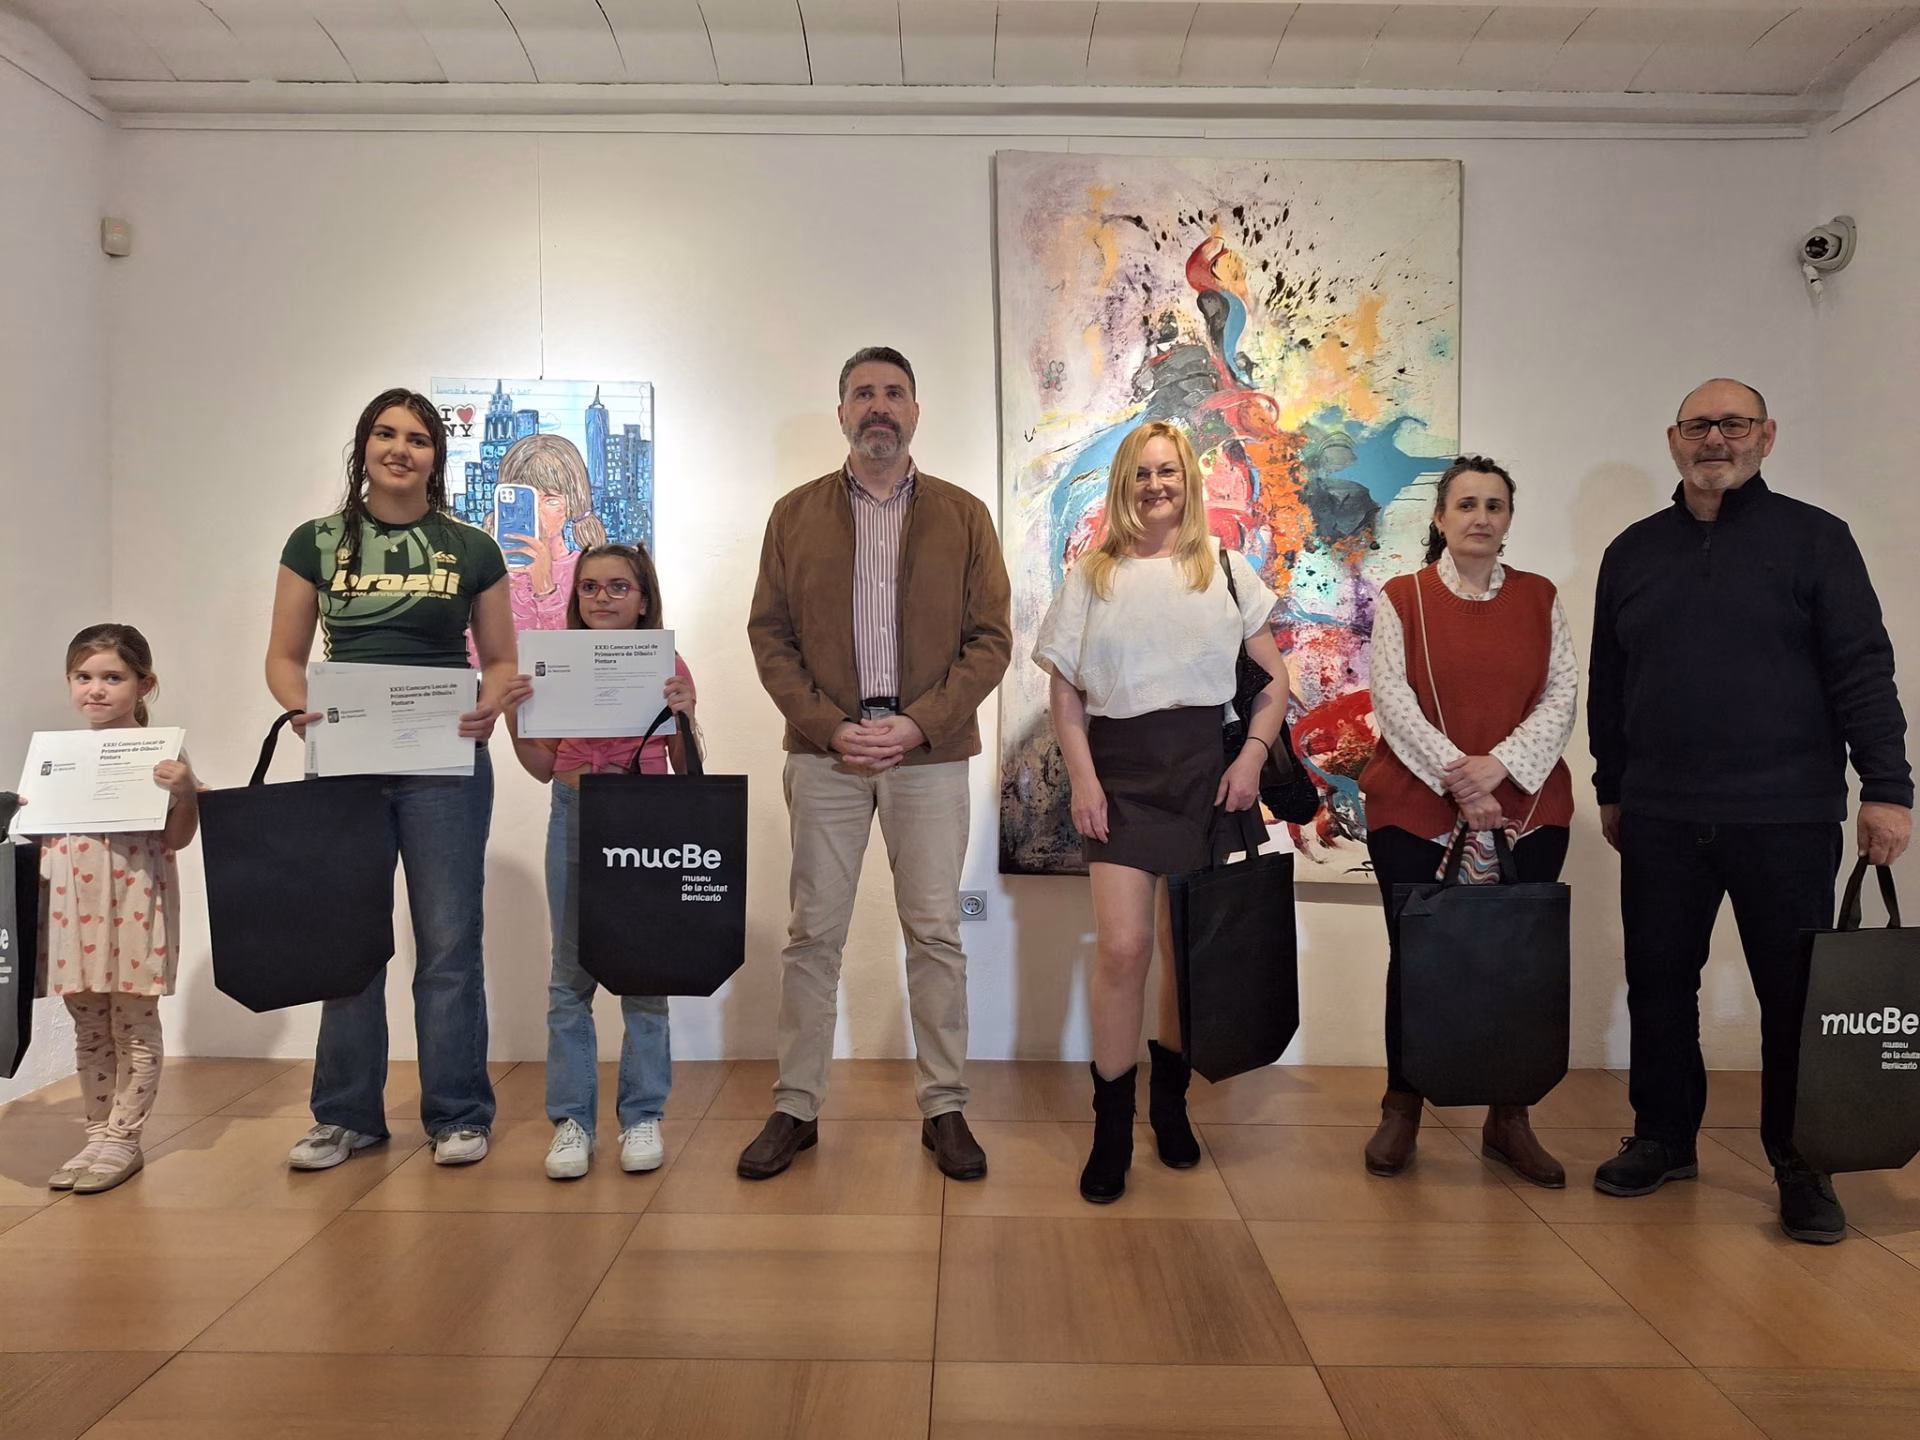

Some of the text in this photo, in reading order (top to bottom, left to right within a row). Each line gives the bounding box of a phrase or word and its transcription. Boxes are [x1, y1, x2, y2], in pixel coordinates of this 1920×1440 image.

[441, 408, 452, 421] I
[445, 424, 473, 437] NY
[330, 568, 460, 595] brazil
[602, 843, 722, 870] mucBe
[681, 883, 728, 892] de la ciutat
[681, 893, 722, 902] Benicarló
[1821, 1006, 1920, 1035] mucBe
